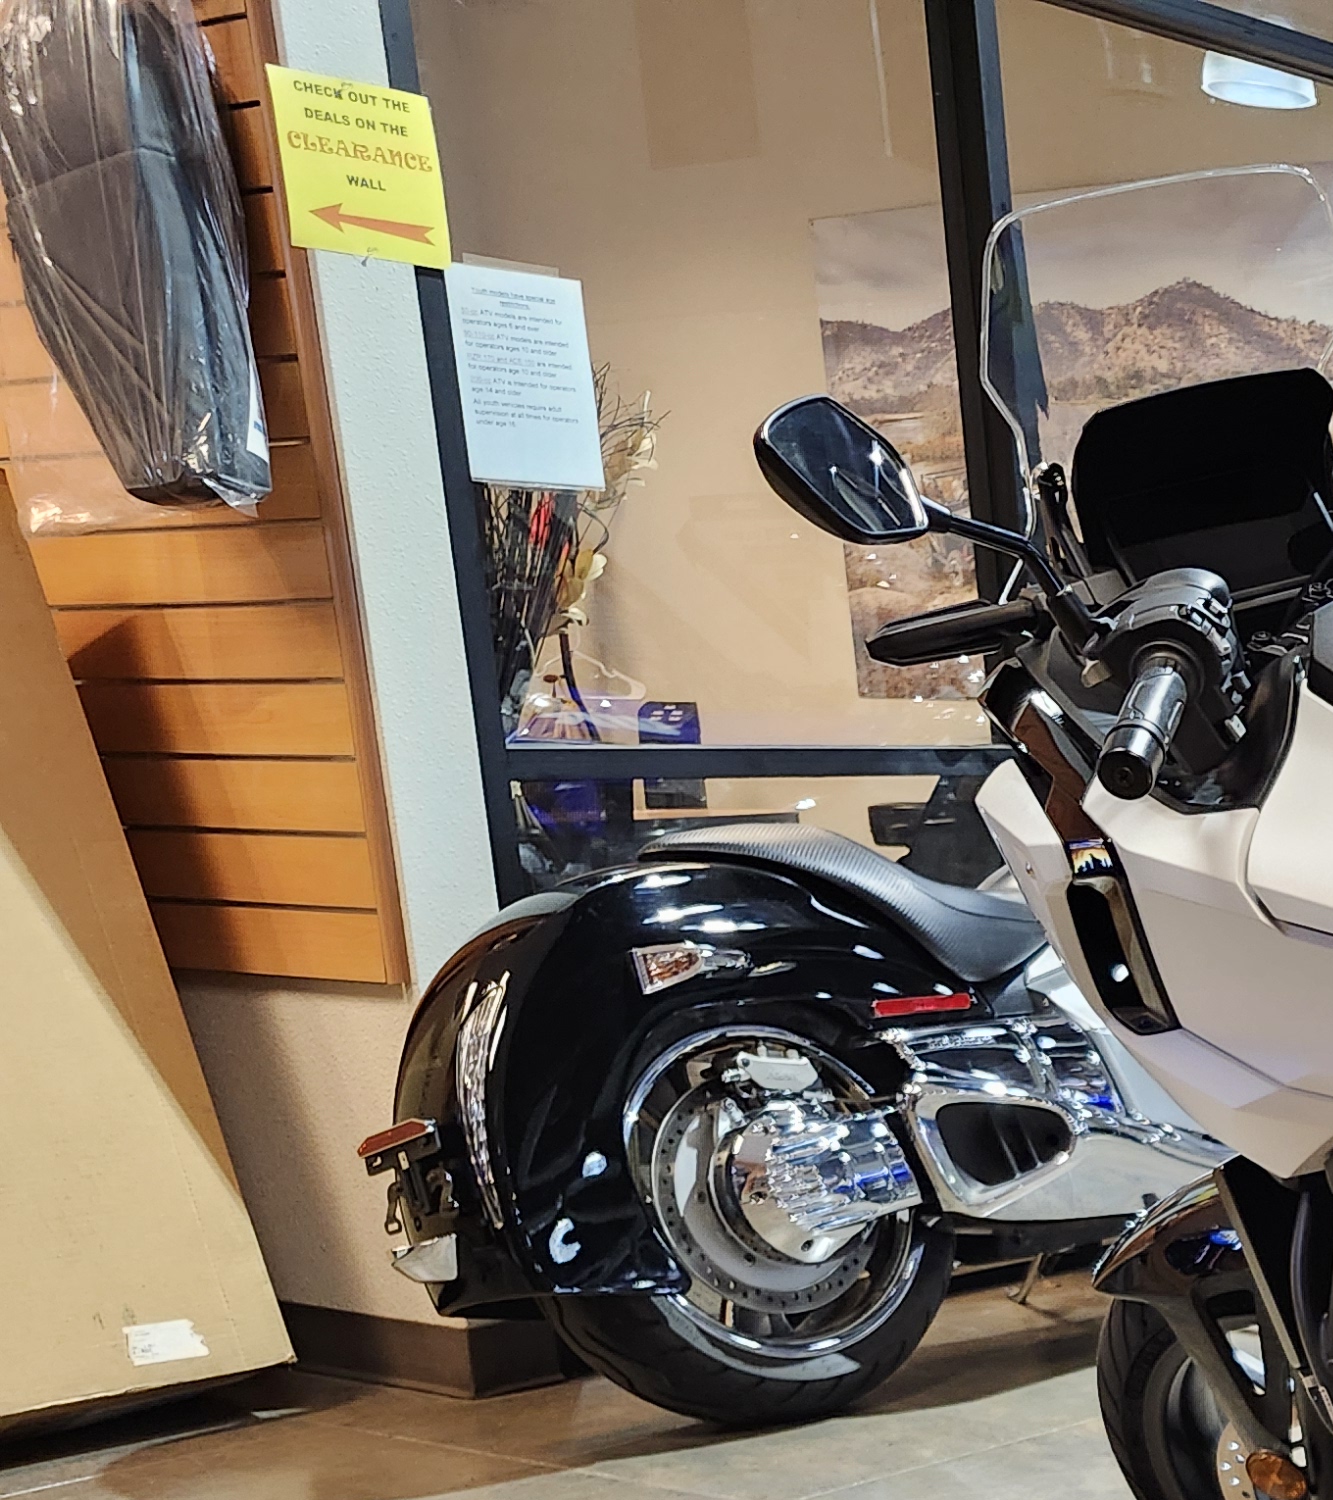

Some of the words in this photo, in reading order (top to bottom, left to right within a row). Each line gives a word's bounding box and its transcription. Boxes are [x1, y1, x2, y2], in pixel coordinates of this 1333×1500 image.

[293, 80, 343, 100] CHECK
[348, 91, 378, 106] OUT
[382, 98, 411, 113] THE
[304, 107, 351, 126] DEALS
[355, 117, 376, 131] ON
[380, 122, 408, 137] THE
[287, 130, 433, 173] CLEARANCE
[346, 174, 387, 192] WALL
